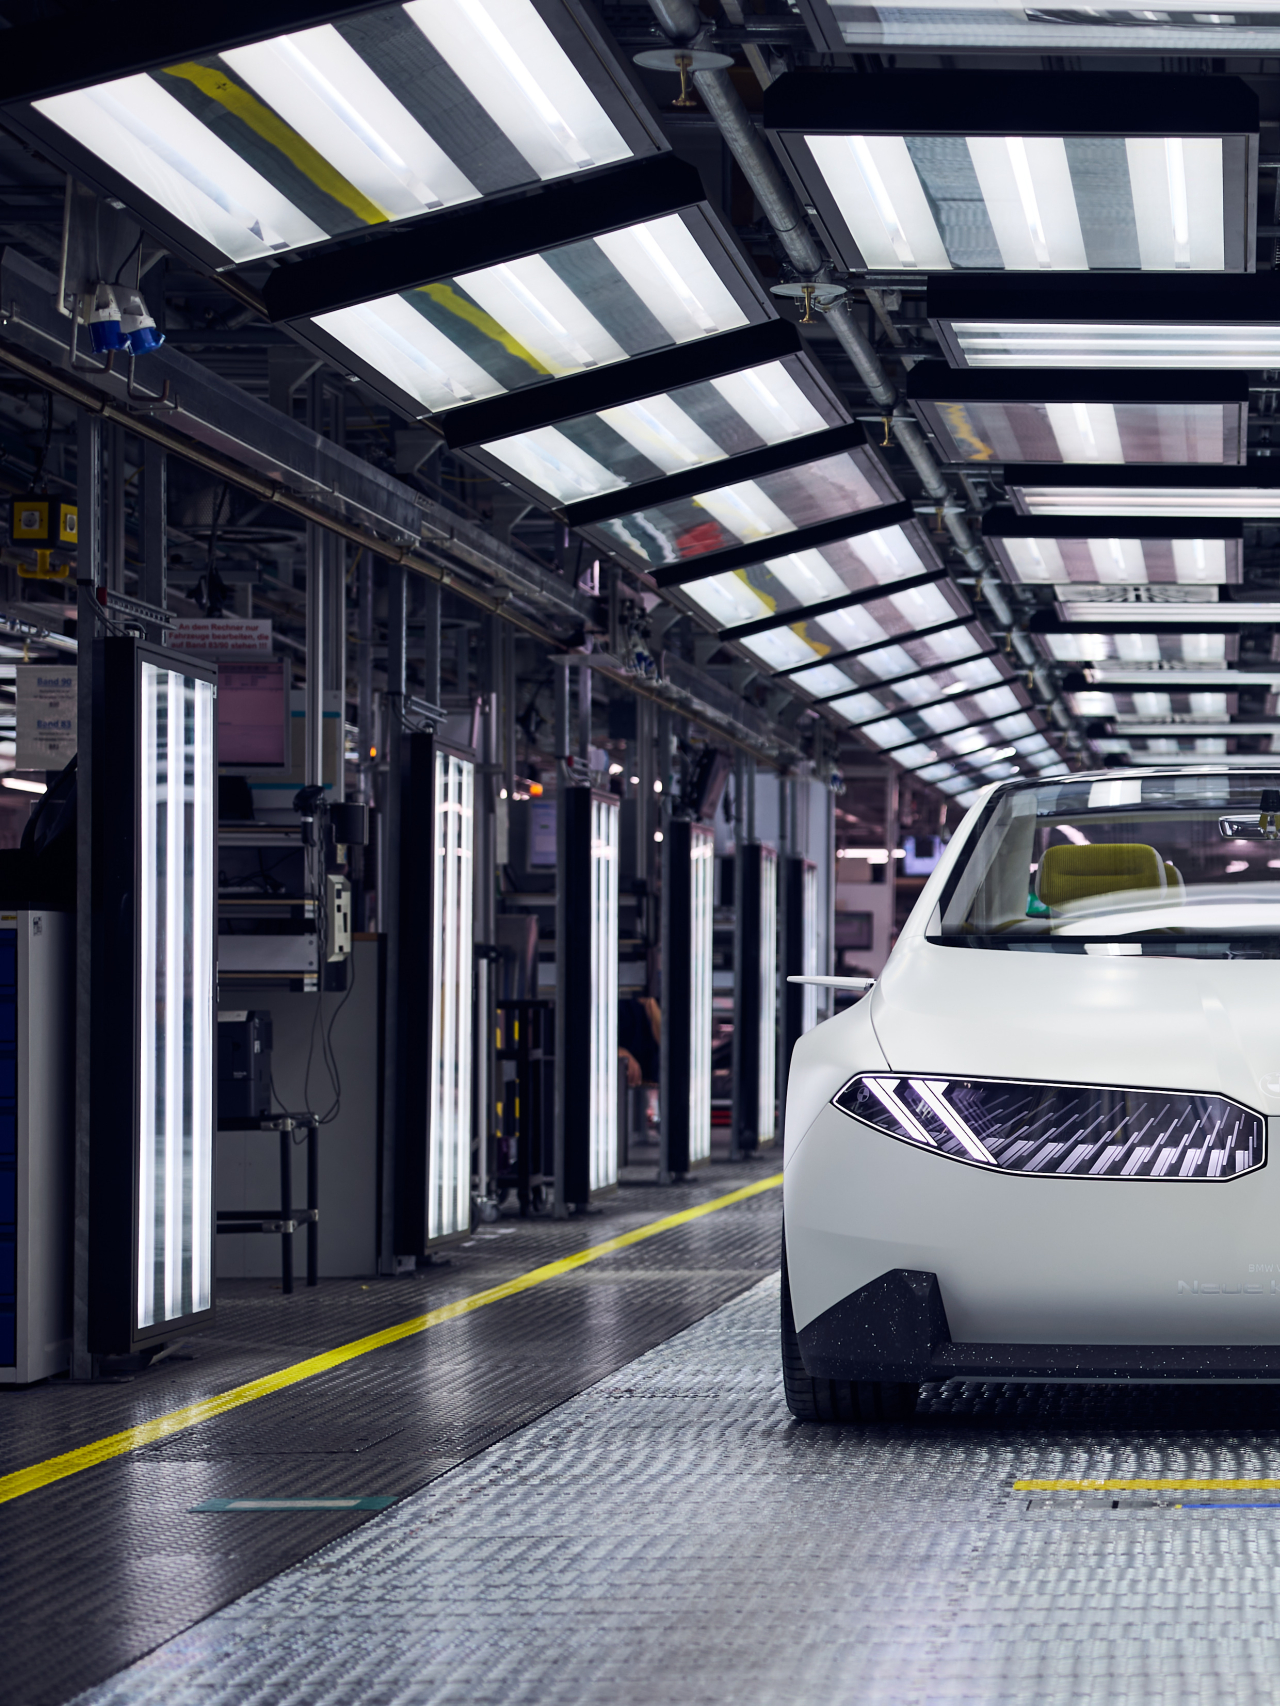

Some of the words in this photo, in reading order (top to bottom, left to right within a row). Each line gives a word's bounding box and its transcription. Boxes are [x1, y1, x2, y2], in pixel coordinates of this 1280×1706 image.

[178, 623, 190, 631] An
[192, 623, 209, 631] dem
[211, 623, 243, 631] Rechner
[168, 632, 210, 641] Fahrzeuge
[171, 641, 183, 649] auf
[185, 641, 206, 649] Band
[37, 677, 59, 686] Band
[37, 720, 59, 729] Band
[1248, 1263, 1274, 1273] BMW
[1177, 1279, 1264, 1296] Neue
